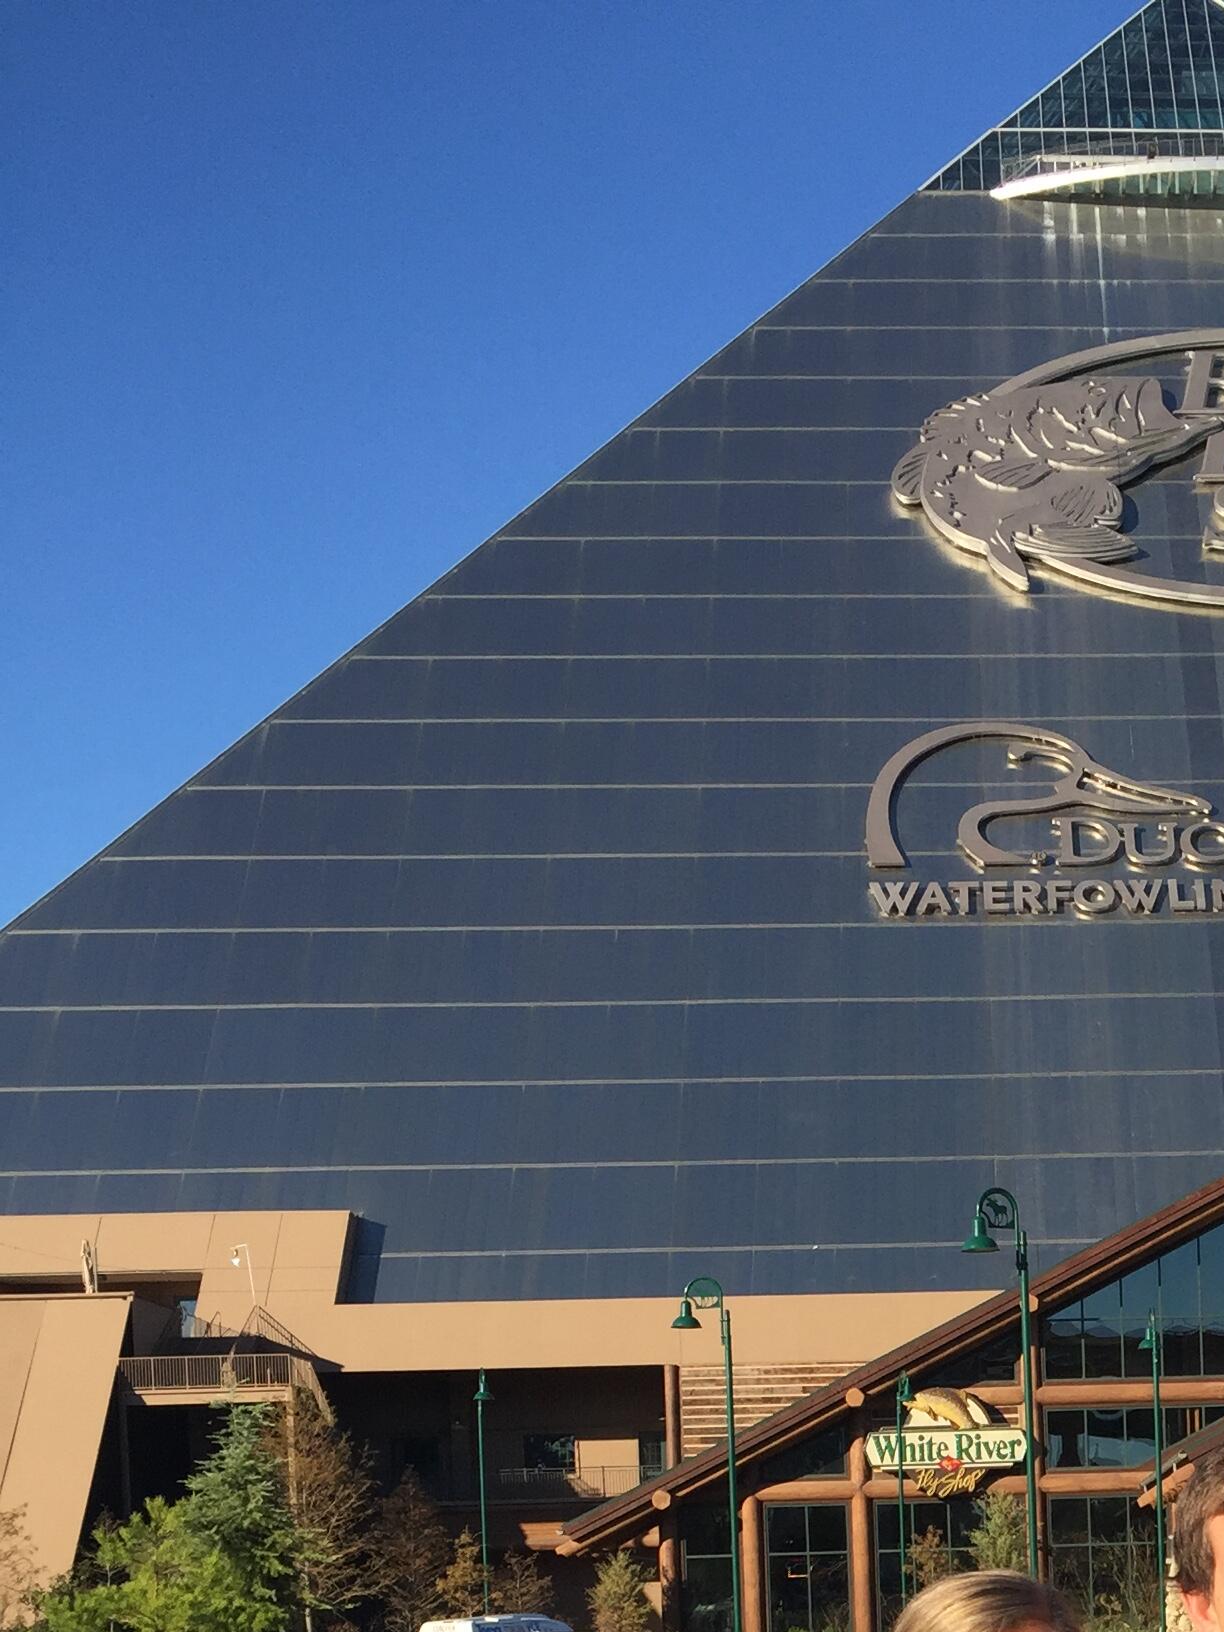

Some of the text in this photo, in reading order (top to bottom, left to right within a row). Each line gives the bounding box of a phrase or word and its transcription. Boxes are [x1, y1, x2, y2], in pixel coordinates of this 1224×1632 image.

[871, 1433, 1022, 1465] White River
[915, 1468, 986, 1498] Fly Shop
